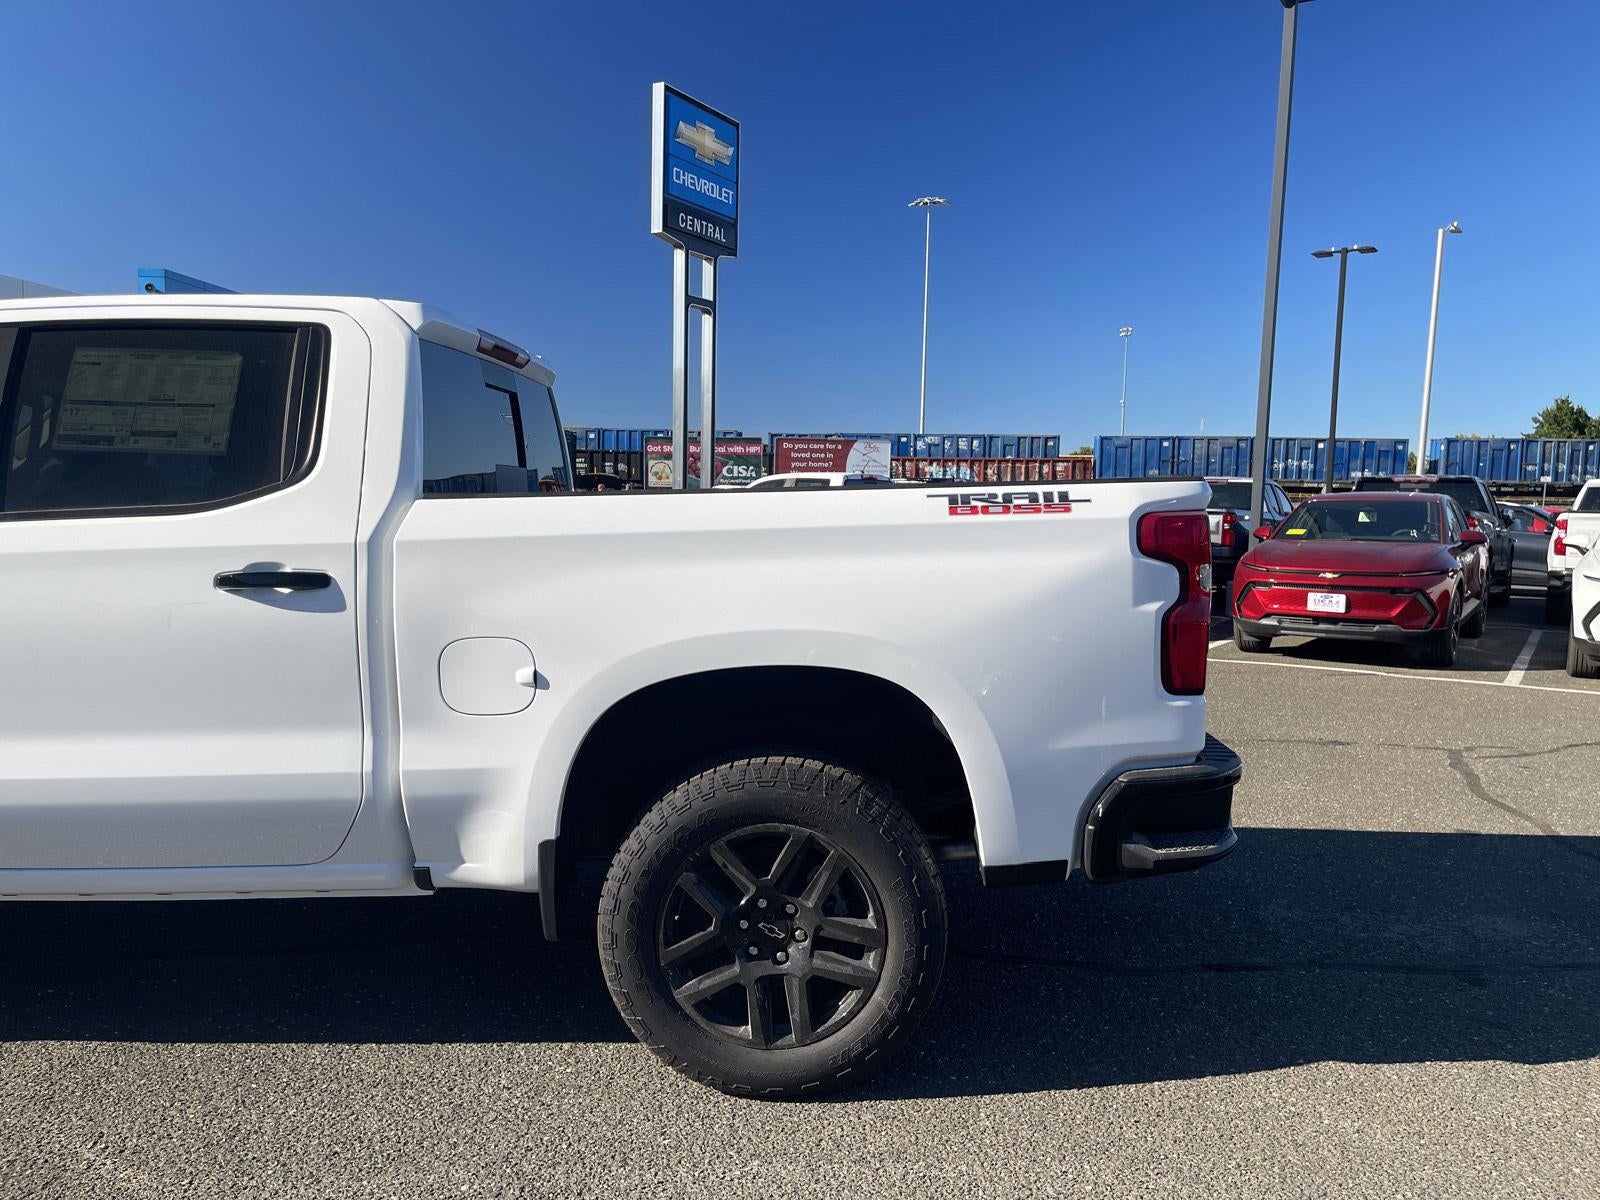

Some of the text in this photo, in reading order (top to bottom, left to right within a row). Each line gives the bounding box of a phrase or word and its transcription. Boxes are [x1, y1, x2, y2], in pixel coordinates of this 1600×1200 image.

[673, 167, 734, 205] CHEVROLET
[678, 212, 726, 243] CENTRAL
[722, 465, 757, 477] CISA
[926, 490, 1091, 506] TRAIL
[948, 503, 1072, 516] BOSS
